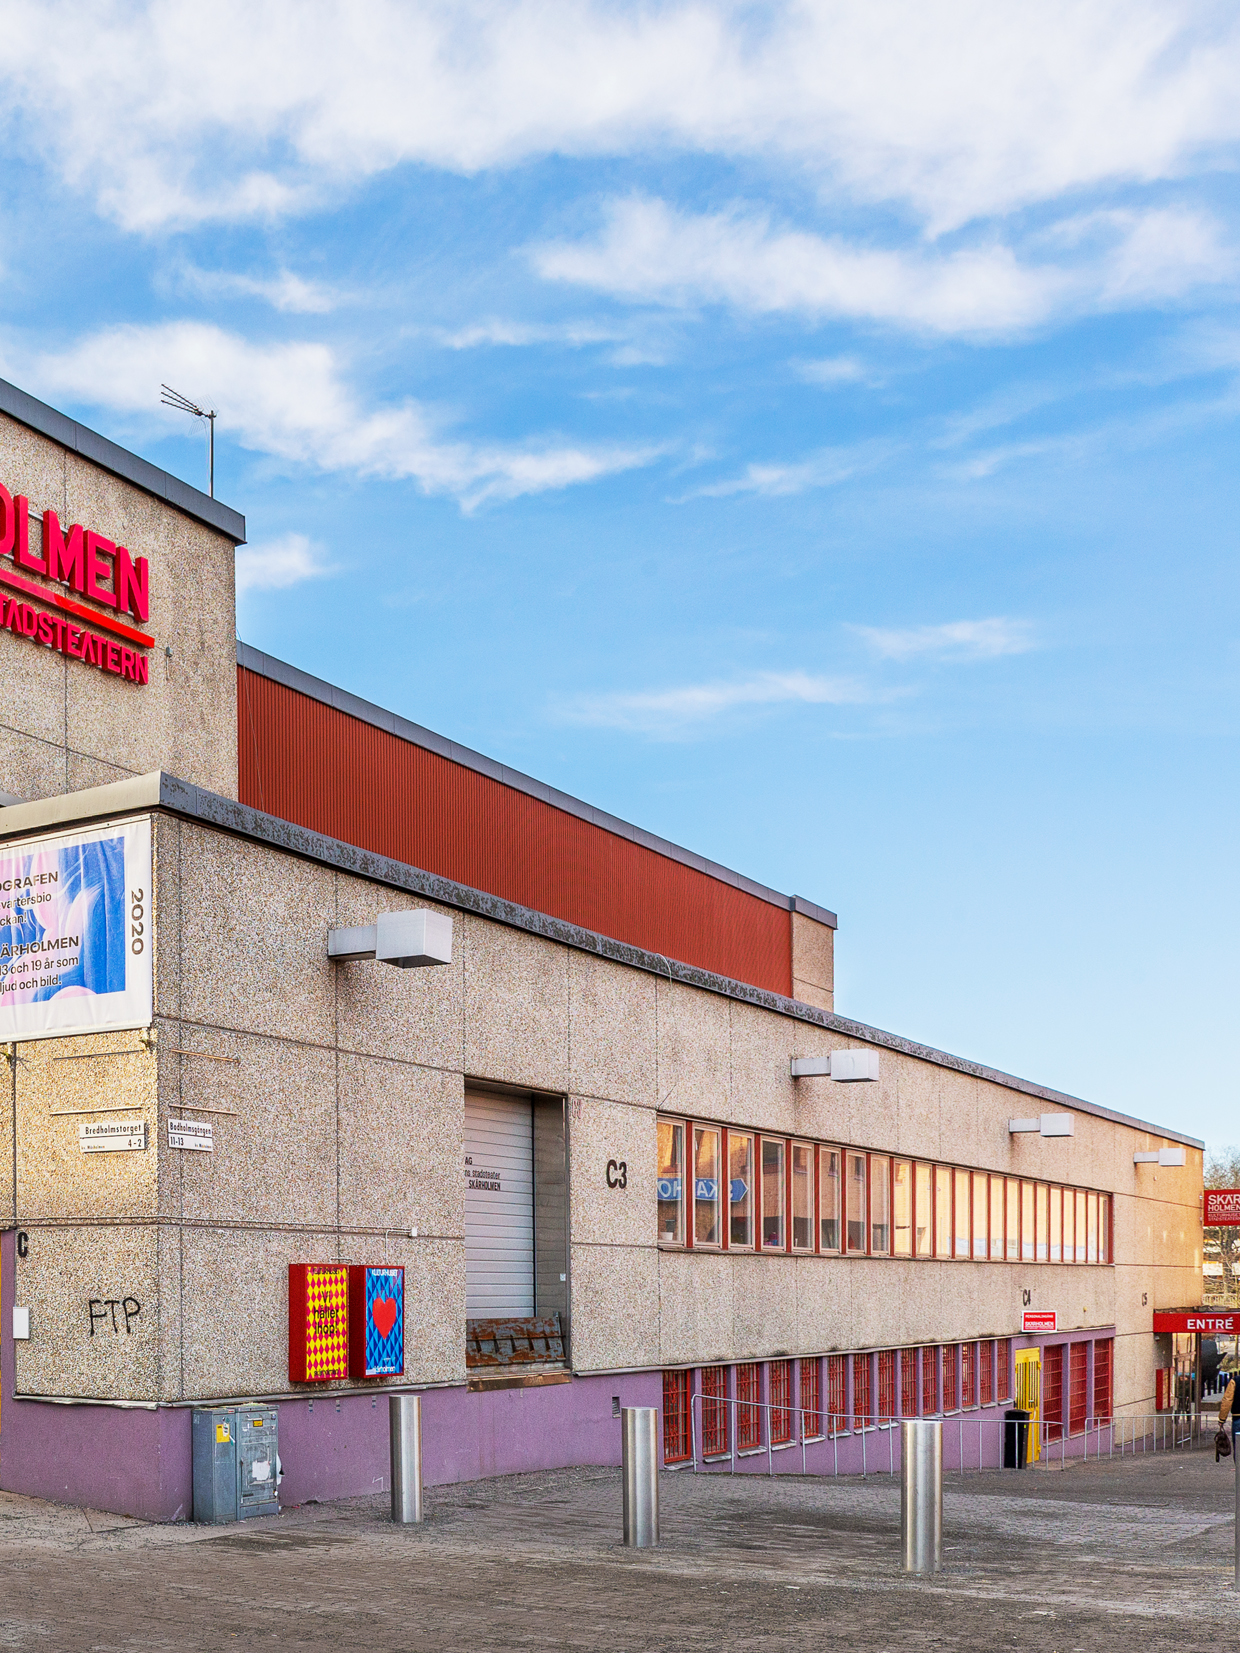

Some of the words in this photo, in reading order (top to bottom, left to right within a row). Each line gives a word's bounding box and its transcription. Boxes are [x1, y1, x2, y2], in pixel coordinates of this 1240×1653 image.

[131, 888, 144, 956] 2020
[10, 961, 29, 975] och
[31, 960, 42, 972] 19
[44, 956, 54, 970] år
[56, 957, 79, 968] som
[0, 979, 18, 995] ljud
[19, 978, 38, 990] och
[40, 974, 62, 988] bild.
[85, 1124, 141, 1136] Bredholmstorget
[170, 1137, 184, 1146] 11-13
[606, 1159, 628, 1189] C3
[1208, 1194, 1240, 1205] SKÄR
[18, 1232, 28, 1258] C
[322, 1291, 330, 1303] Vi
[1023, 1289, 1031, 1306] C4
[89, 1297, 140, 1337] FTP
[314, 1305, 339, 1320] håller
[315, 1322, 338, 1337] ihop!
[1187, 1317, 1234, 1330] ENTRÉ
